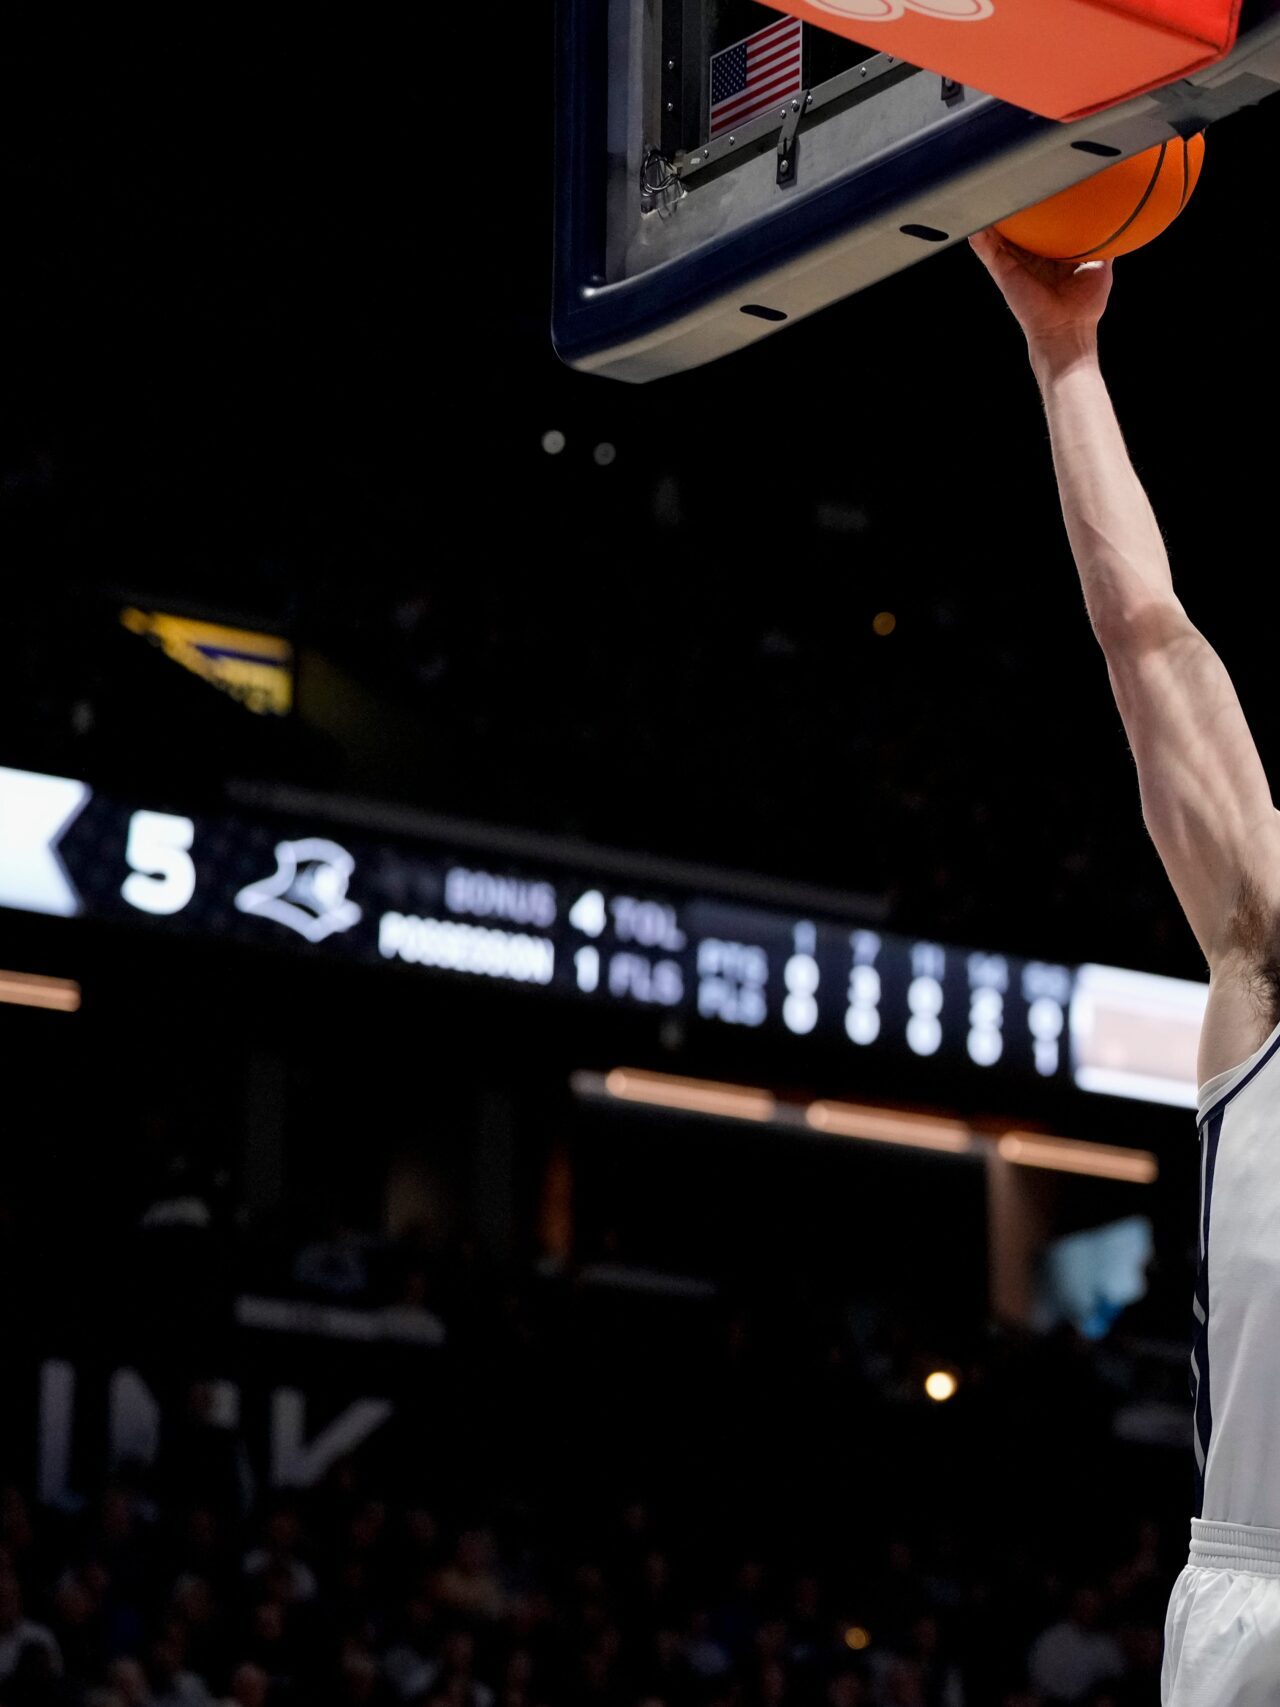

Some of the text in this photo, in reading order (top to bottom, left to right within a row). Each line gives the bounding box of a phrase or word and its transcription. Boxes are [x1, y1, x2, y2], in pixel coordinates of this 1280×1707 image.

[122, 810, 195, 914] 5
[570, 890, 605, 937] 4
[575, 946, 599, 992] 1
